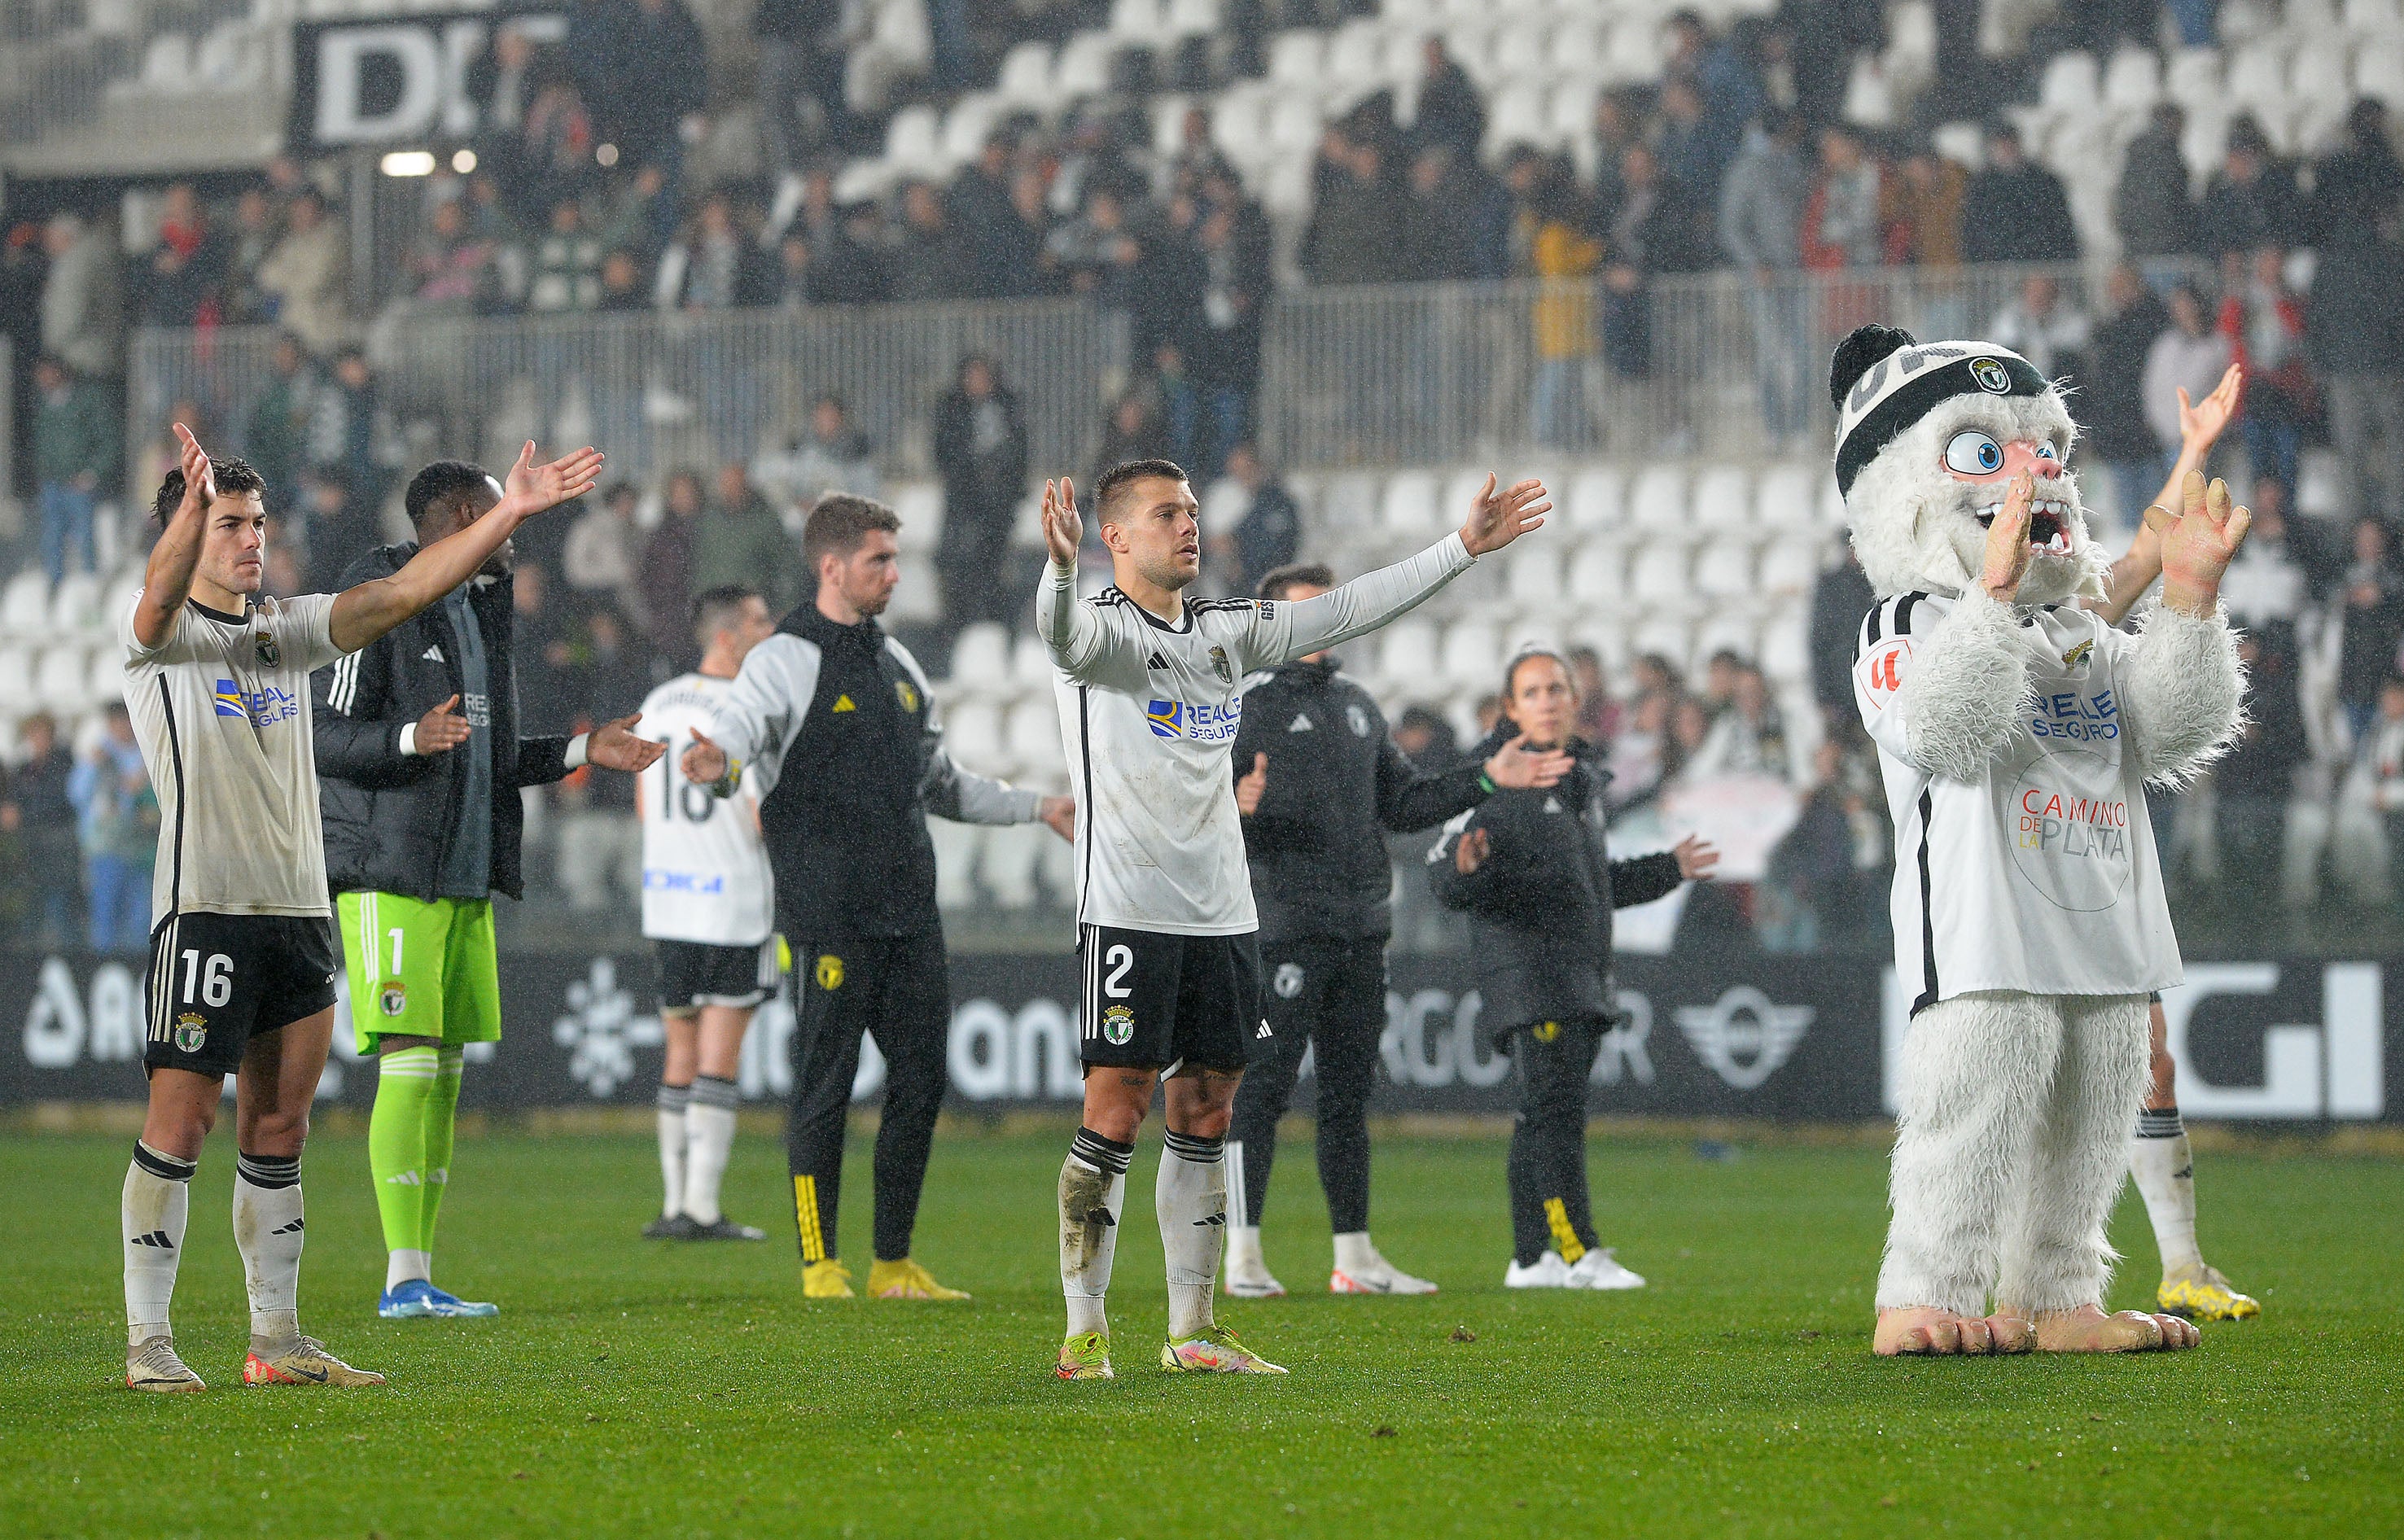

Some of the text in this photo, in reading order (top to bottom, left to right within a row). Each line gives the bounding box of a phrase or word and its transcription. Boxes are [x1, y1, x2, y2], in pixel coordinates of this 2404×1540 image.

[2021, 816, 2041, 833] DE
[2022, 790, 2126, 827] CAMINO
[2019, 833, 2039, 850] LA
[2041, 818, 2127, 862] PLATA
[388, 928, 404, 975] 1
[1105, 944, 1133, 998] 2
[181, 949, 234, 1008] 16
